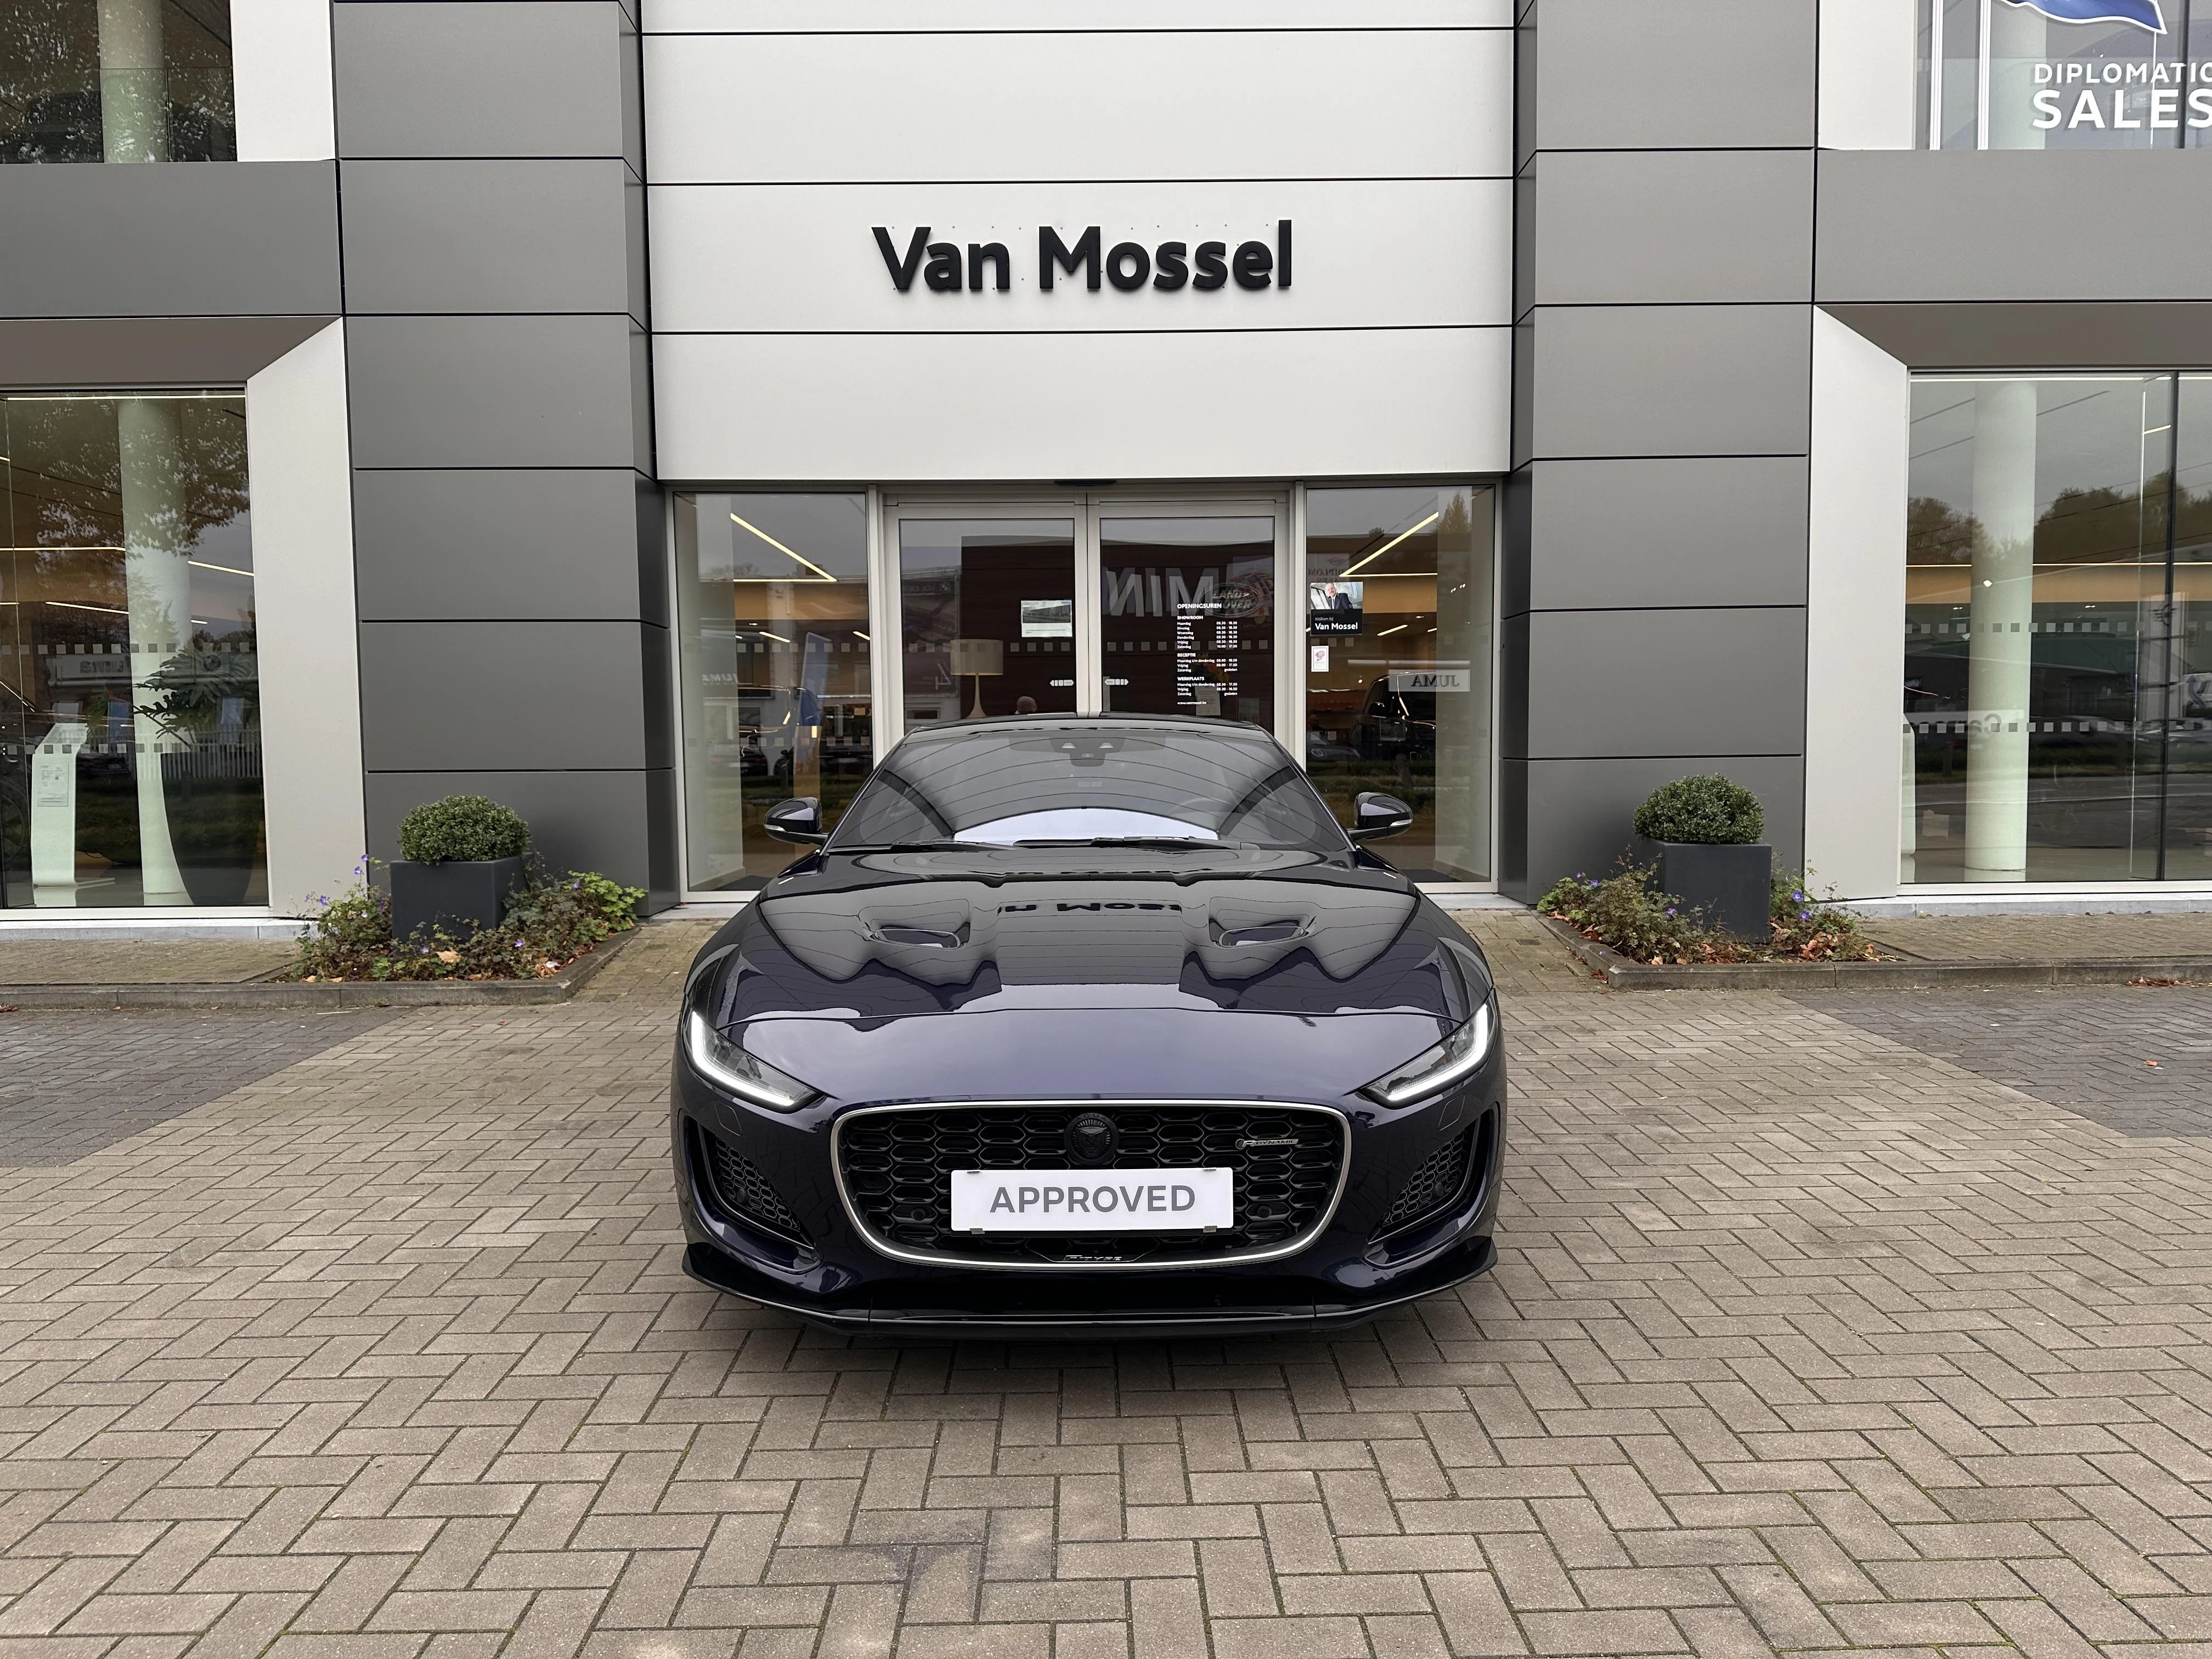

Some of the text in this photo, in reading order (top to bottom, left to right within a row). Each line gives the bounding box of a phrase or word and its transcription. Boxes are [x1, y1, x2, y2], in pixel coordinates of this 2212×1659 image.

[2034, 62, 2212, 84] DIPLOMATIC
[2032, 89, 2212, 129] SALES
[871, 219, 1292, 290] Van Mossel
[990, 1185, 1195, 1213] APPROVED
